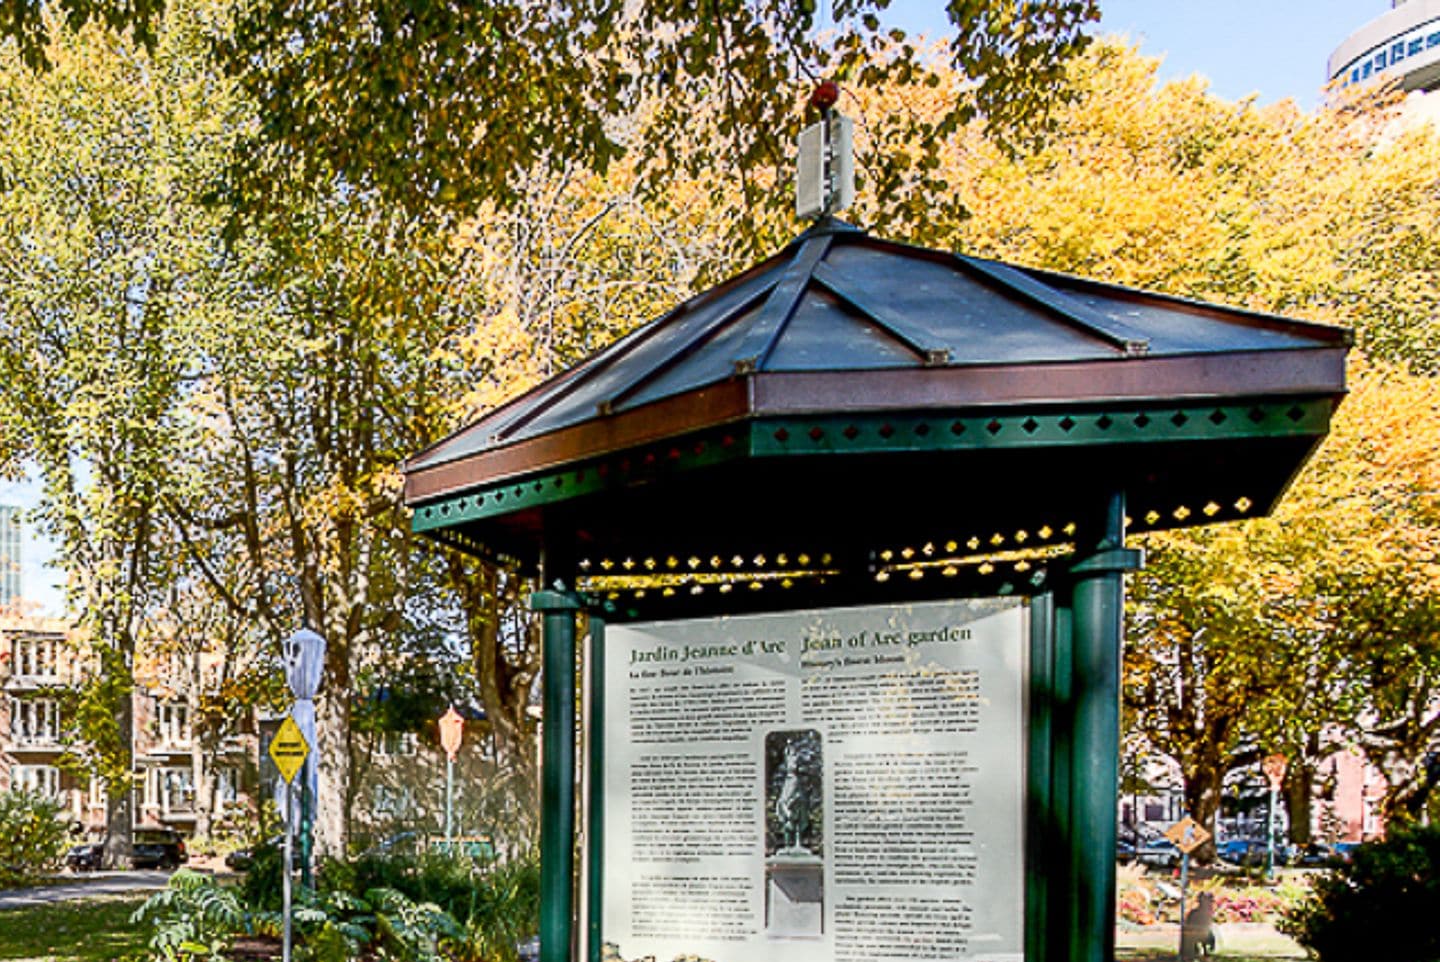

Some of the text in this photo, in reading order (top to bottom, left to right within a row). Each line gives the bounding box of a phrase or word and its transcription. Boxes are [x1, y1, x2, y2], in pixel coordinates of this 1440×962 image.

[630, 640, 785, 664] Jardin Jeanne d'Arc
[800, 626, 972, 653] Joan of Arc garden
